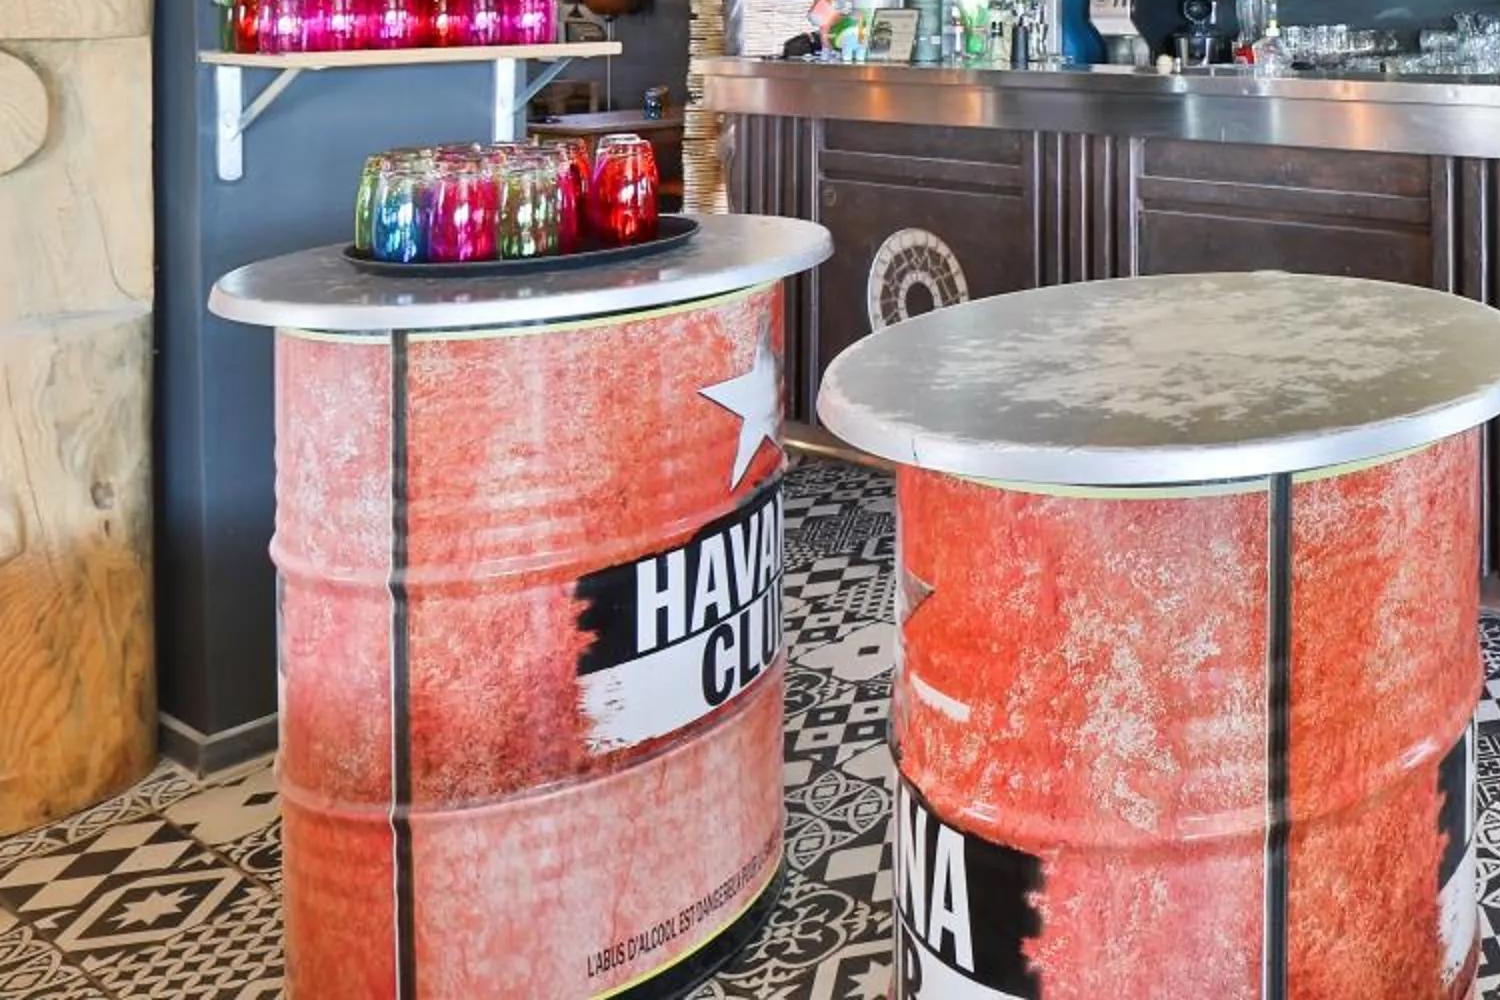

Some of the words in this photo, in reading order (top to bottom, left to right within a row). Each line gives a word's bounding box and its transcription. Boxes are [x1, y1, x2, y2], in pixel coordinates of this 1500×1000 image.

[587, 943, 625, 977] L'ABUS
[627, 918, 677, 961] D'ALCOOL
[679, 905, 695, 934] EST
